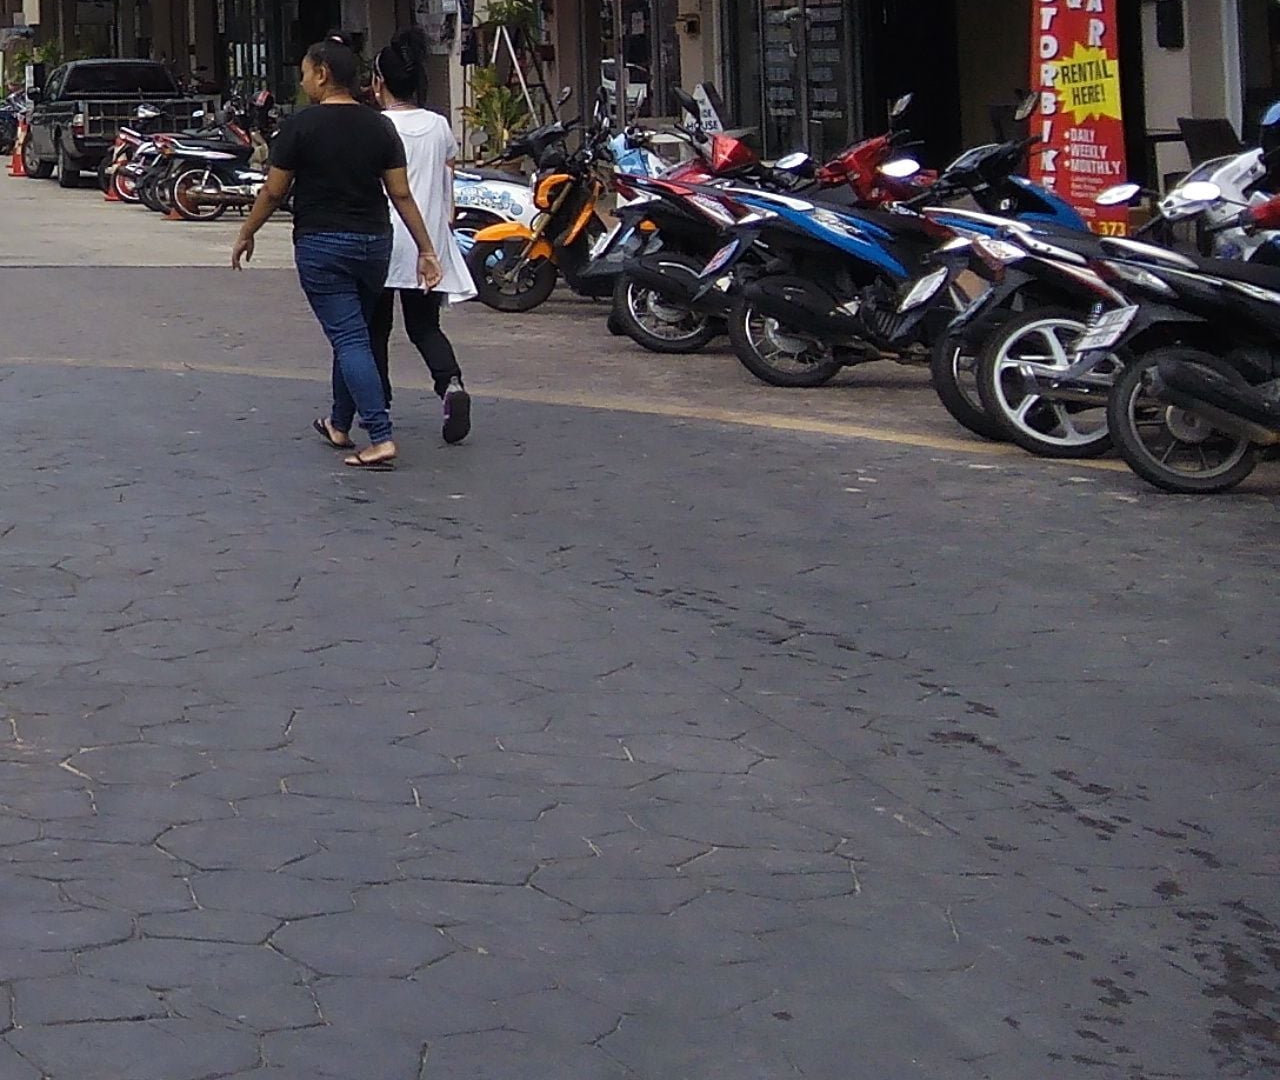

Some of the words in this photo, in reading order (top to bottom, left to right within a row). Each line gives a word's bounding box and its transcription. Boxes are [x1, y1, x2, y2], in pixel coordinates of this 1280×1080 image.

[1061, 59, 1114, 85] RENTAL
[1072, 83, 1106, 107] HERE!
[1070, 128, 1095, 142] DAILY
[1070, 143, 1107, 159] WEEKLY
[1070, 158, 1121, 175] MONTHLY
